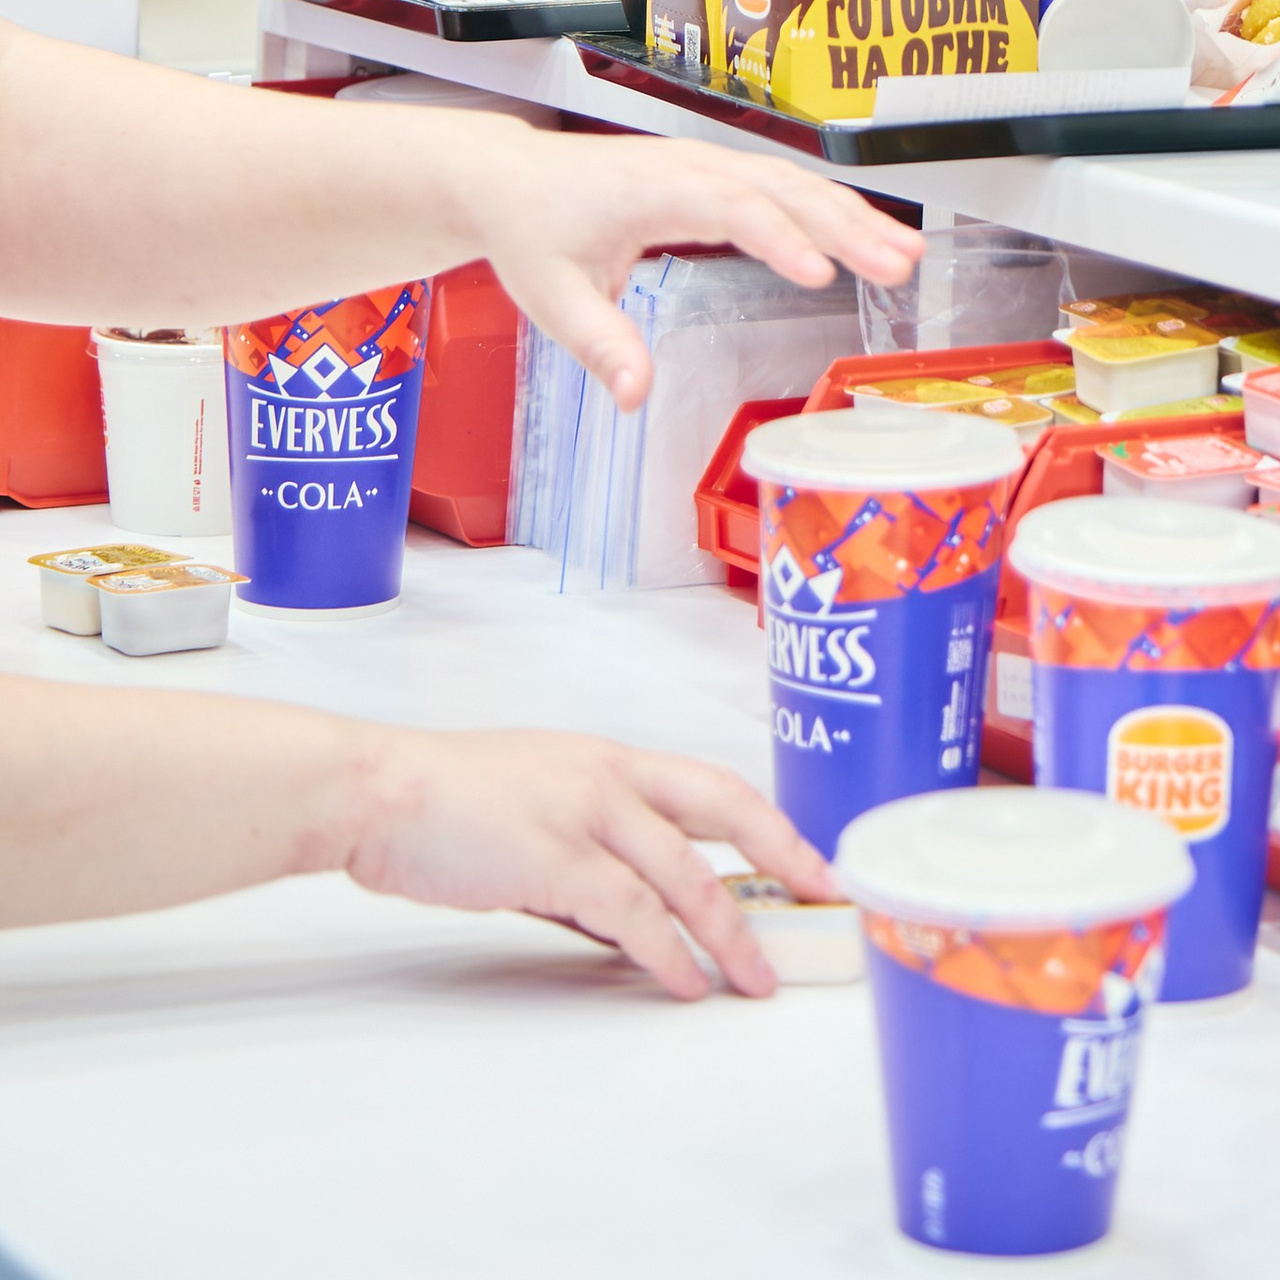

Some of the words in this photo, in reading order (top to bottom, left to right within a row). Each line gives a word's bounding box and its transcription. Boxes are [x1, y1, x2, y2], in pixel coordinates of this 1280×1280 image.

[828, 44, 889, 89] НА
[901, 30, 1010, 77] ОГНЕ
[251, 398, 398, 452] EVERVESS
[277, 481, 364, 511] COLA
[1116, 749, 1223, 775] BURGER
[1116, 775, 1222, 810] KING
